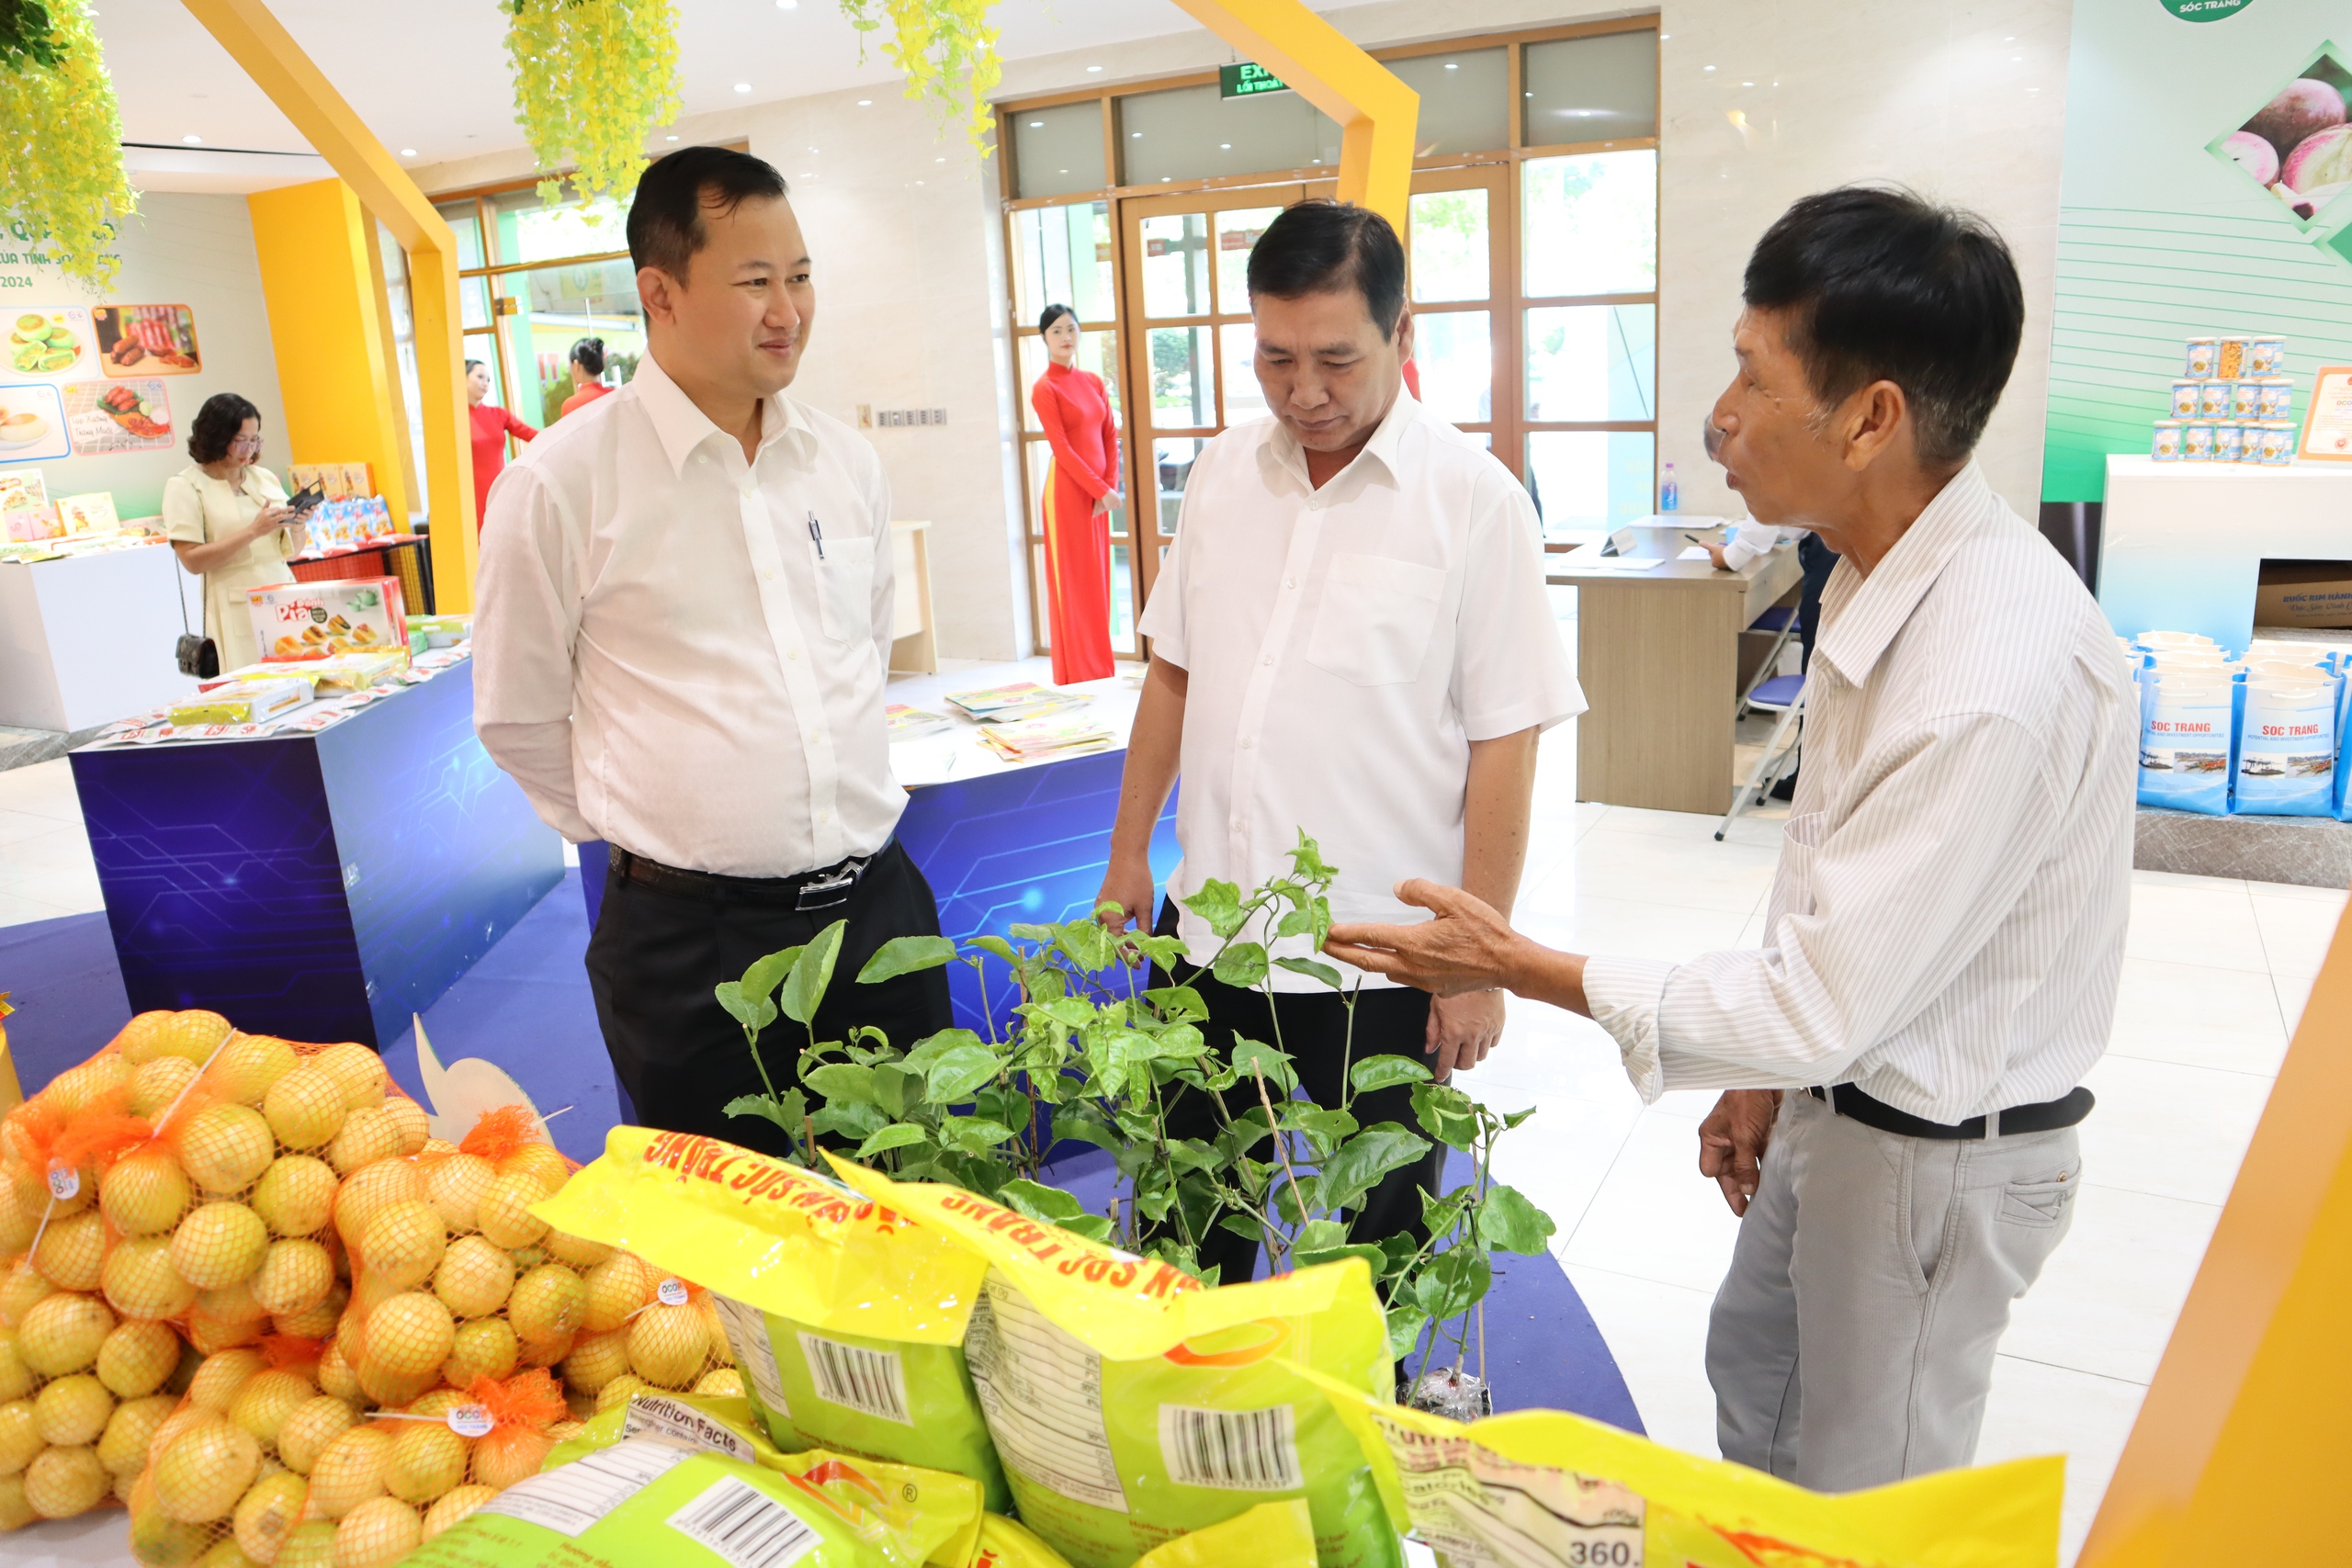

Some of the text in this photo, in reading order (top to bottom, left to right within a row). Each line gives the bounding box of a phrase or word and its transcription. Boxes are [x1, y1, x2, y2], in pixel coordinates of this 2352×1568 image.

[0, 276, 33, 288] 2024
[2151, 720, 2211, 732] SOC TRANG
[2262, 724, 2319, 736] SOC TRANG
[631, 1396, 694, 1428] Nutrition
[695, 1417, 736, 1452] Facts
